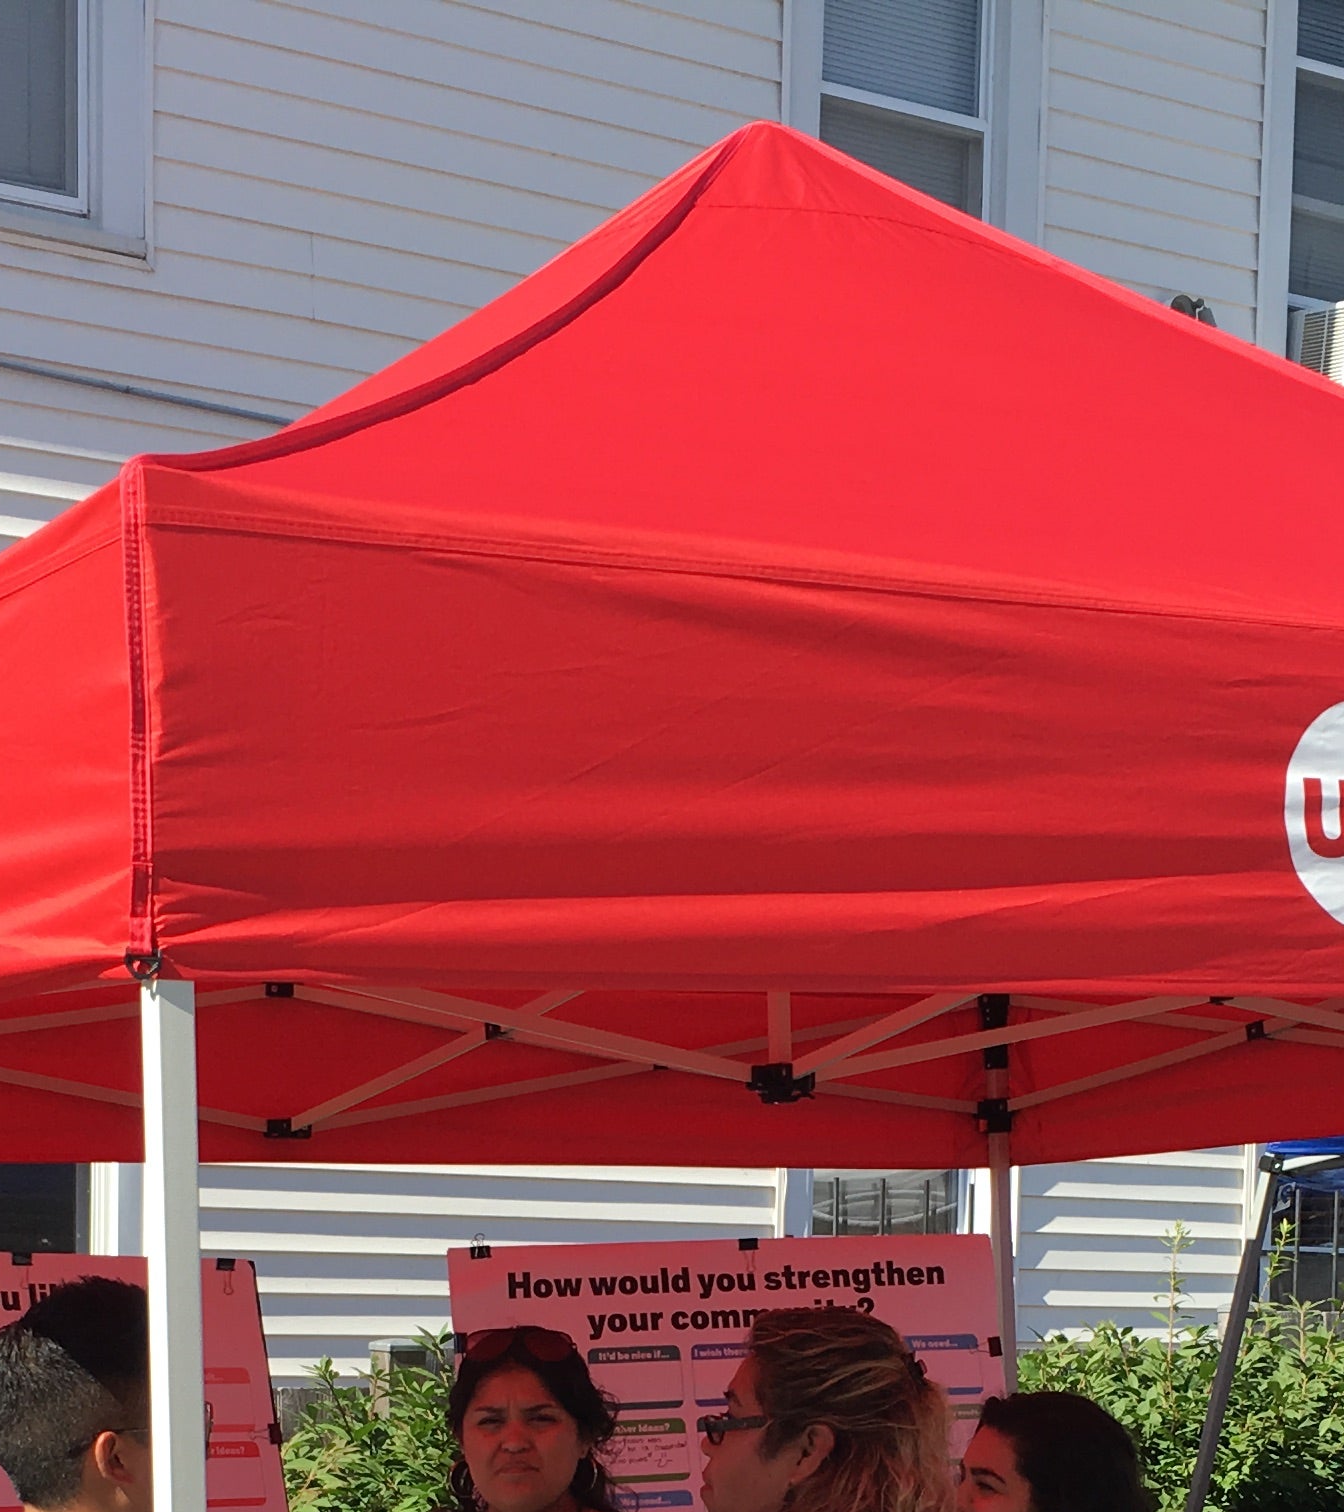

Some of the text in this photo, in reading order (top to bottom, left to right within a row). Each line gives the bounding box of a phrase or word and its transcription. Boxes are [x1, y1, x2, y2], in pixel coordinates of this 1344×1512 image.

[507, 1261, 945, 1299] How would you strengthen
[587, 1312, 664, 1340] your
[617, 1352, 630, 1360] be
[631, 1351, 653, 1360] nice
